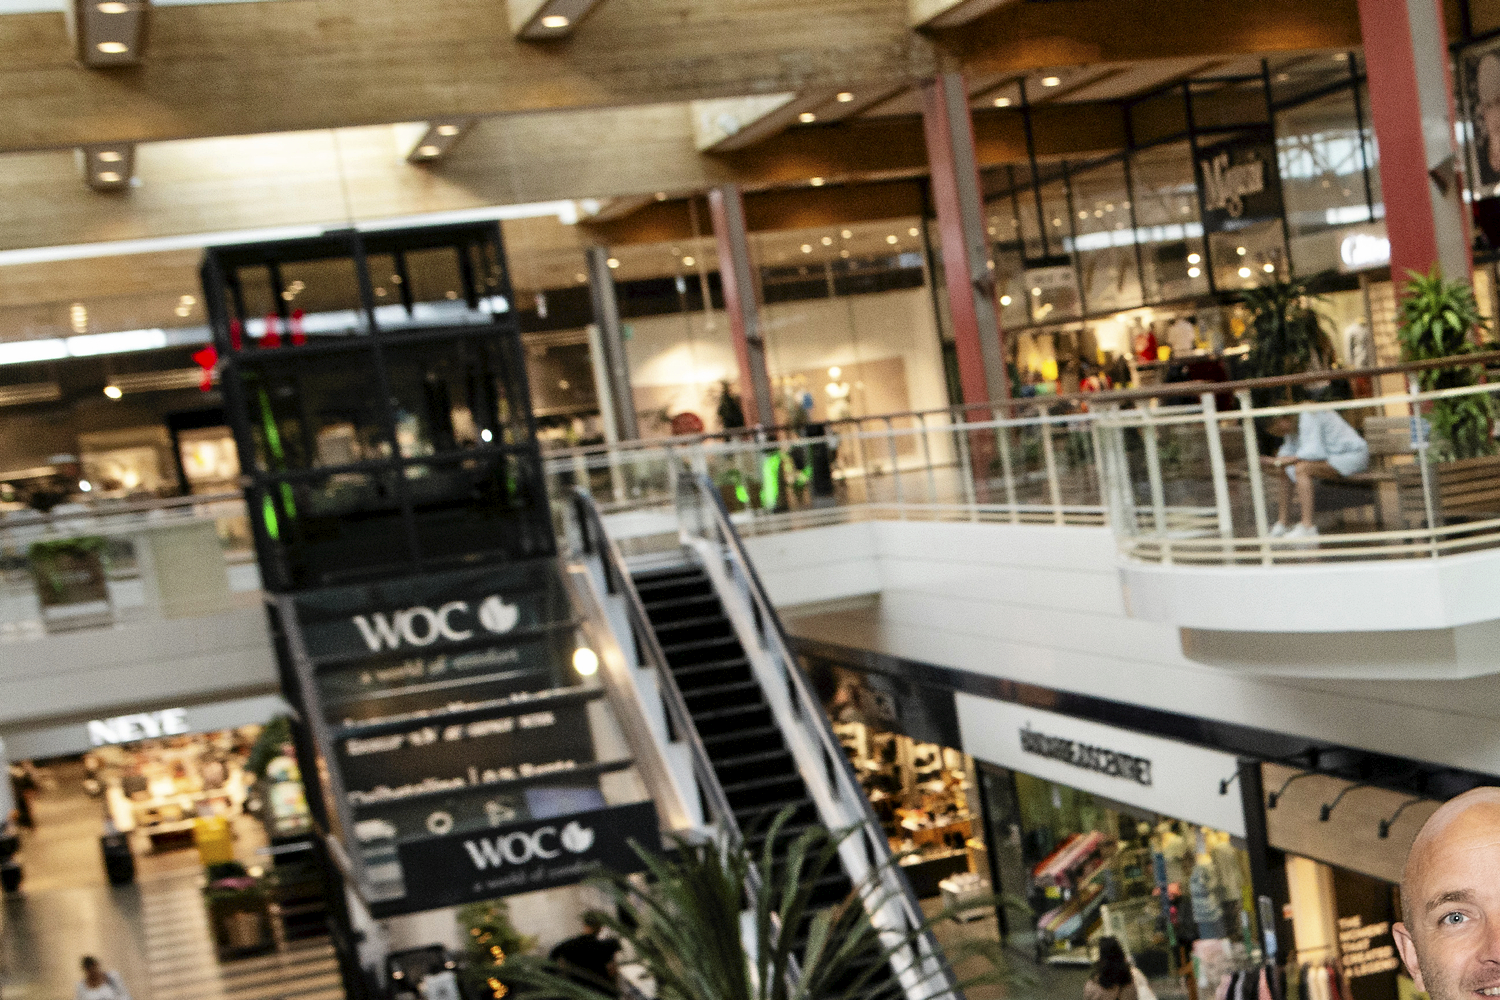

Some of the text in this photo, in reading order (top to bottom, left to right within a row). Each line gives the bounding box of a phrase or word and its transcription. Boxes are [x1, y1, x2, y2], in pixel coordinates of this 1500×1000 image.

[352, 601, 473, 651] WOC
[88, 707, 189, 746] NEYE
[463, 825, 562, 871] WOC
